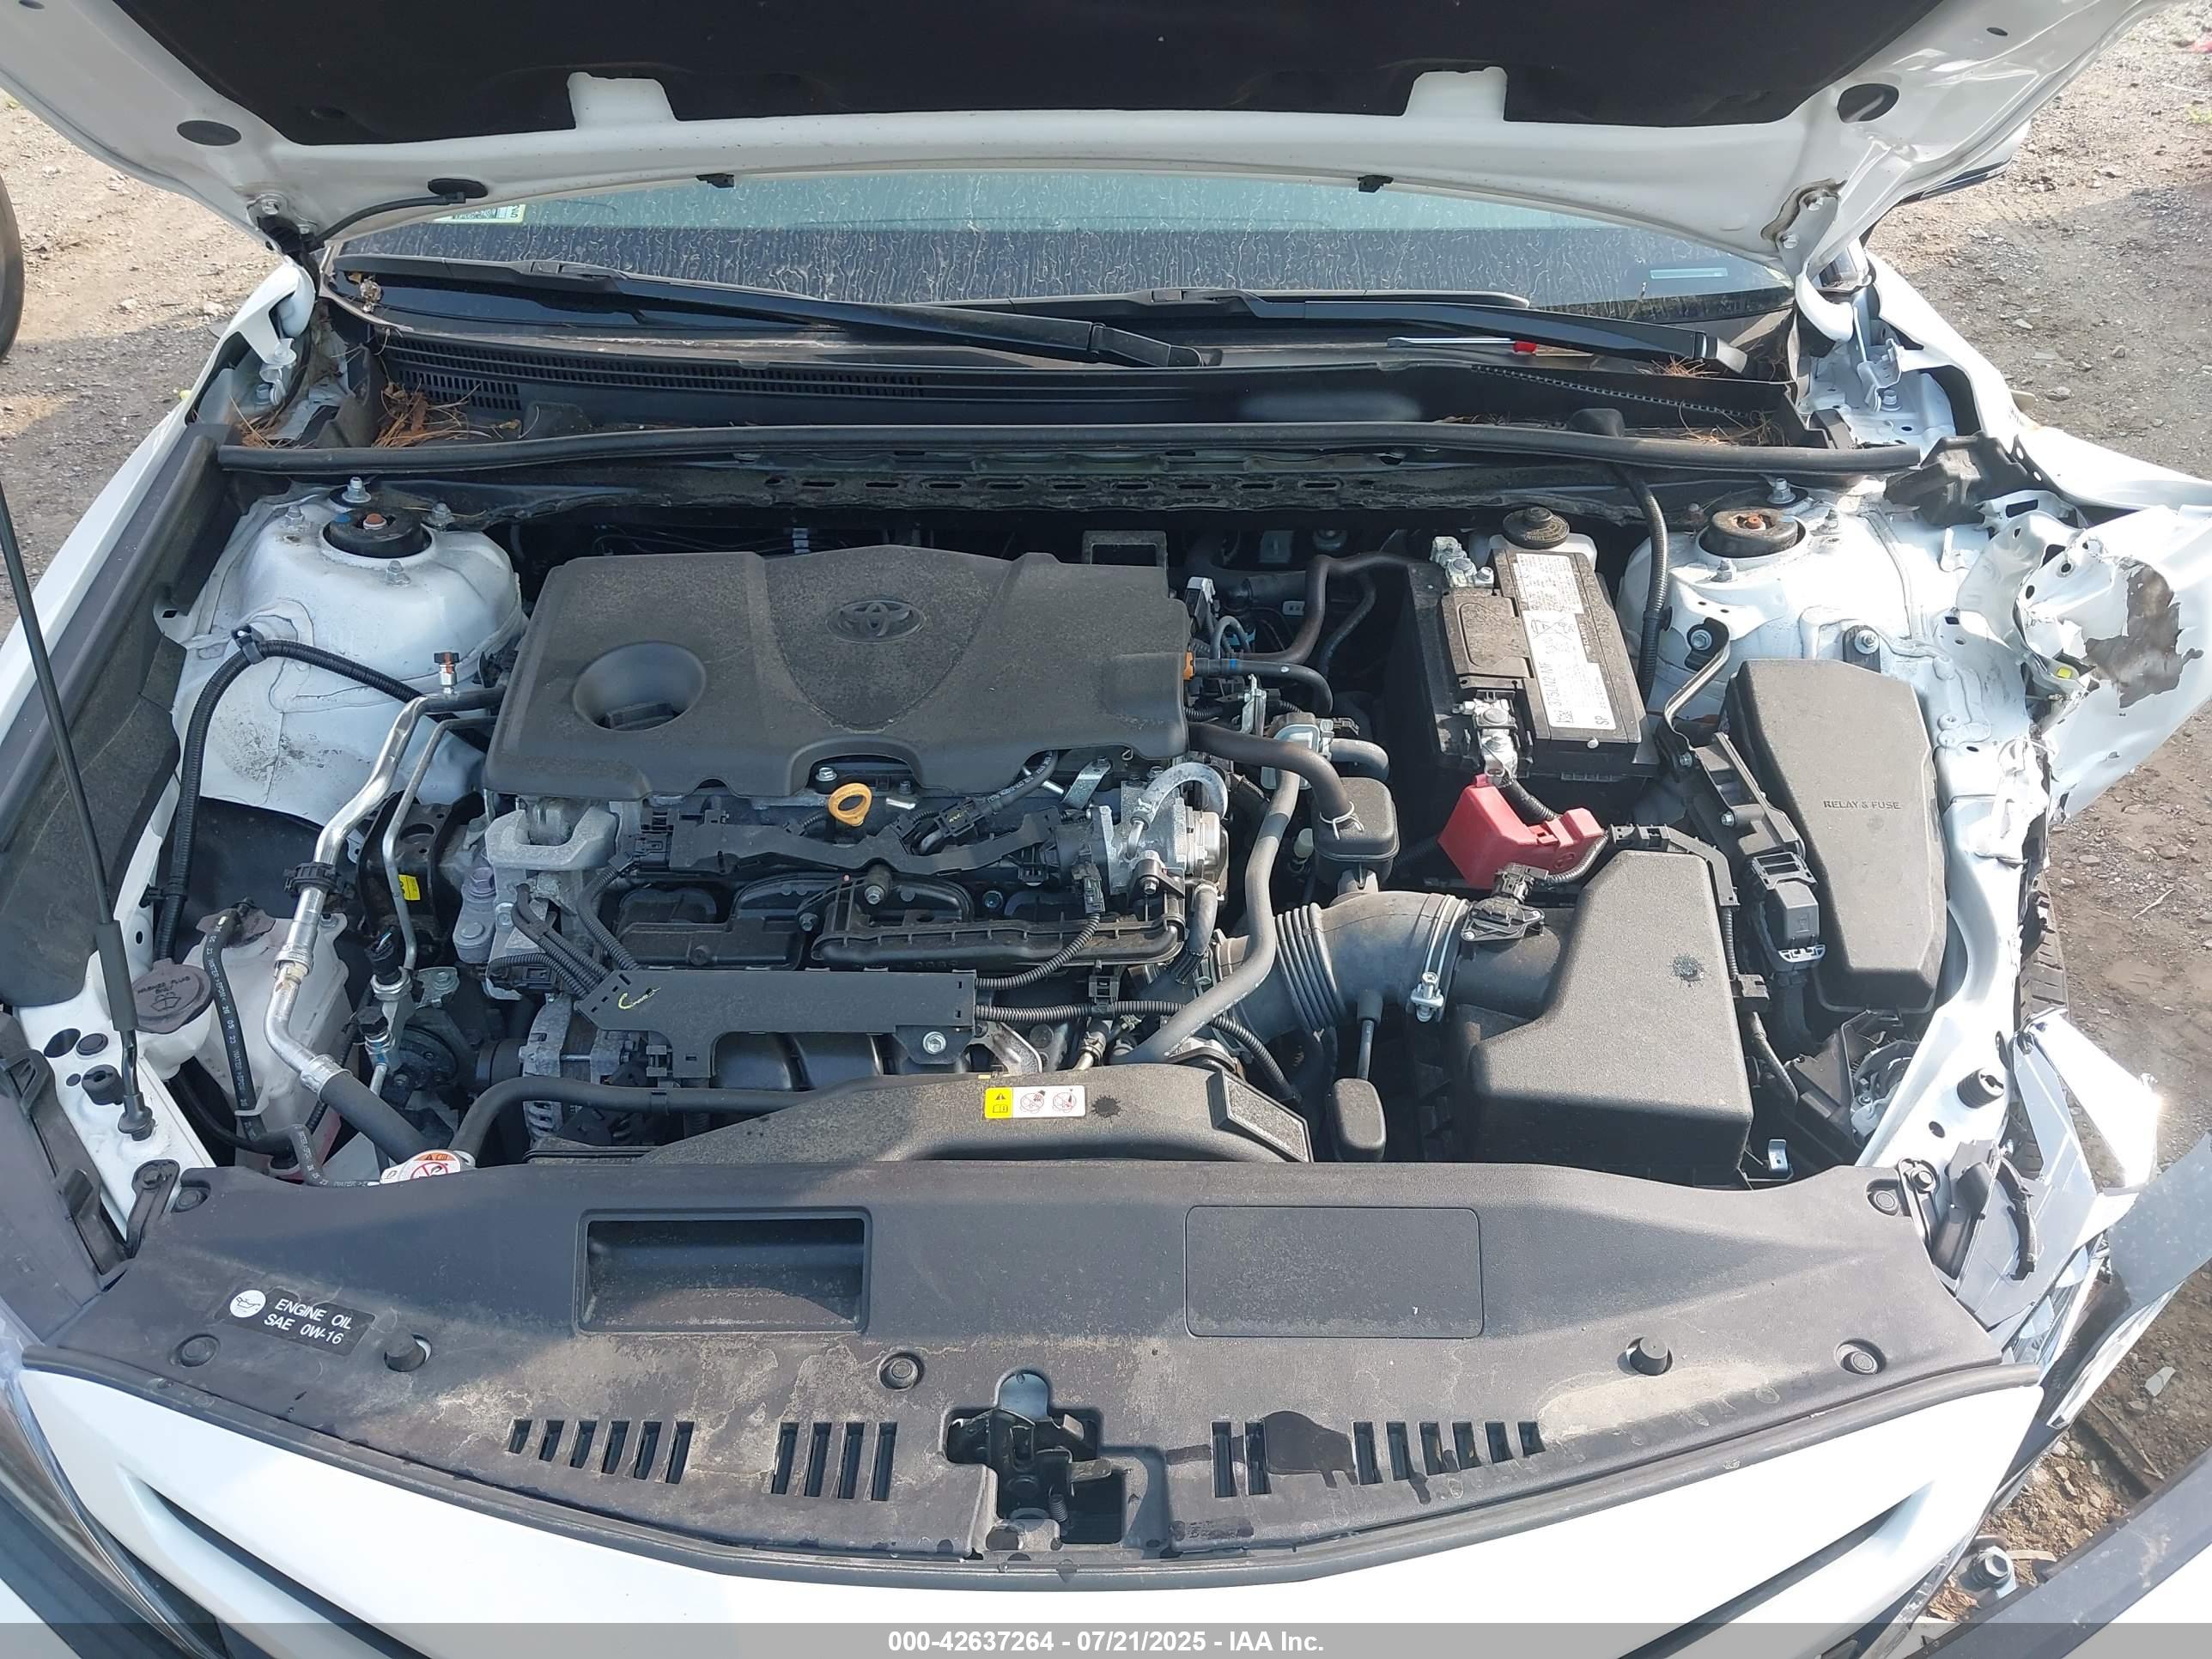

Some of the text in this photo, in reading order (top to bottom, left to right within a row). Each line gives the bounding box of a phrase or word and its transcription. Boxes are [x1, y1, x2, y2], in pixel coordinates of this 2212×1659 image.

[1823, 799, 1902, 810] RELAY & FUSE
[275, 1298, 353, 1329] ENGINE OIL
[264, 1313, 344, 1346] SAE 0W-16
